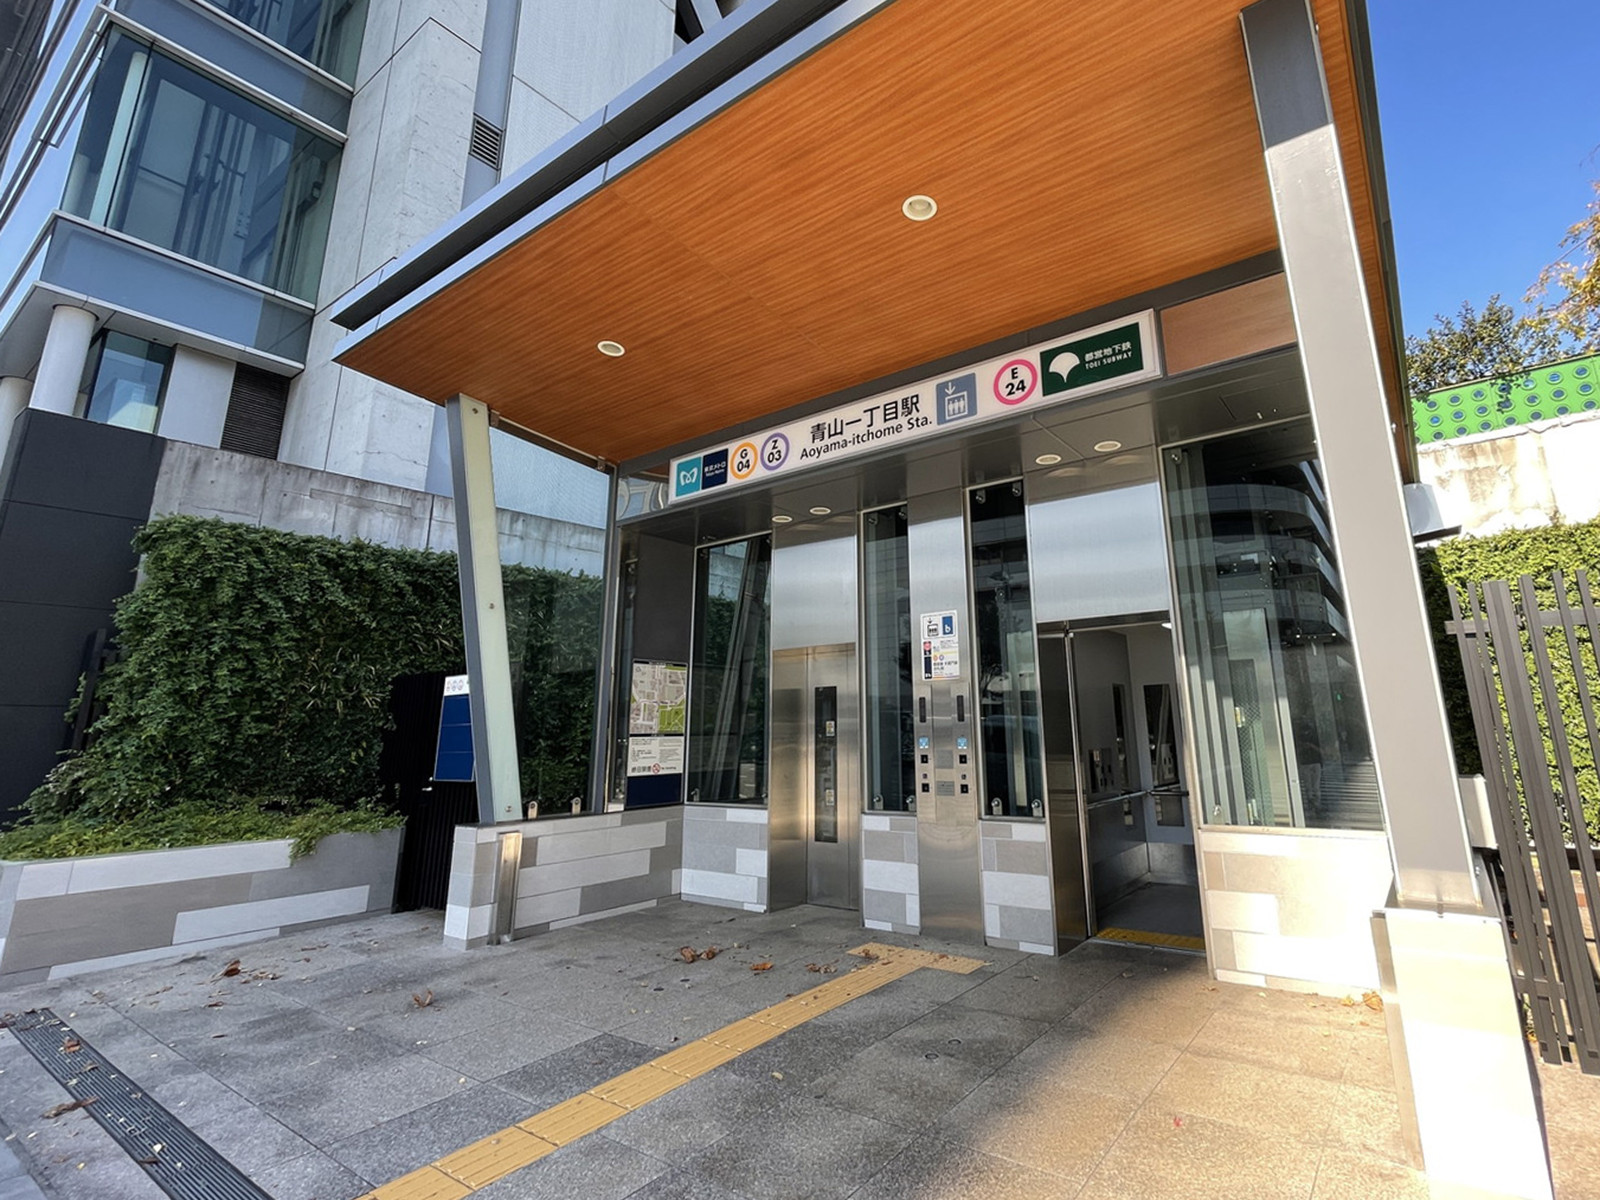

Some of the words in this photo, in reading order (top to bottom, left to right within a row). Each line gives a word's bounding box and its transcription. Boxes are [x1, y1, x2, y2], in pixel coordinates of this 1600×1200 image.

[1084, 341, 1132, 362] 都営地下鉄
[1085, 359, 1101, 370] TOEI
[1103, 351, 1132, 366] SUBWAY
[1011, 367, 1018, 380] E
[1005, 379, 1026, 397] 24
[810, 394, 920, 443] 青山一丁目駅
[771, 439, 778, 450] Z
[800, 423, 903, 460] Aoyama-itchome
[907, 415, 933, 431] Sta.
[740, 448, 748, 459] G
[767, 450, 782, 463] 03
[737, 459, 751, 472] 04
